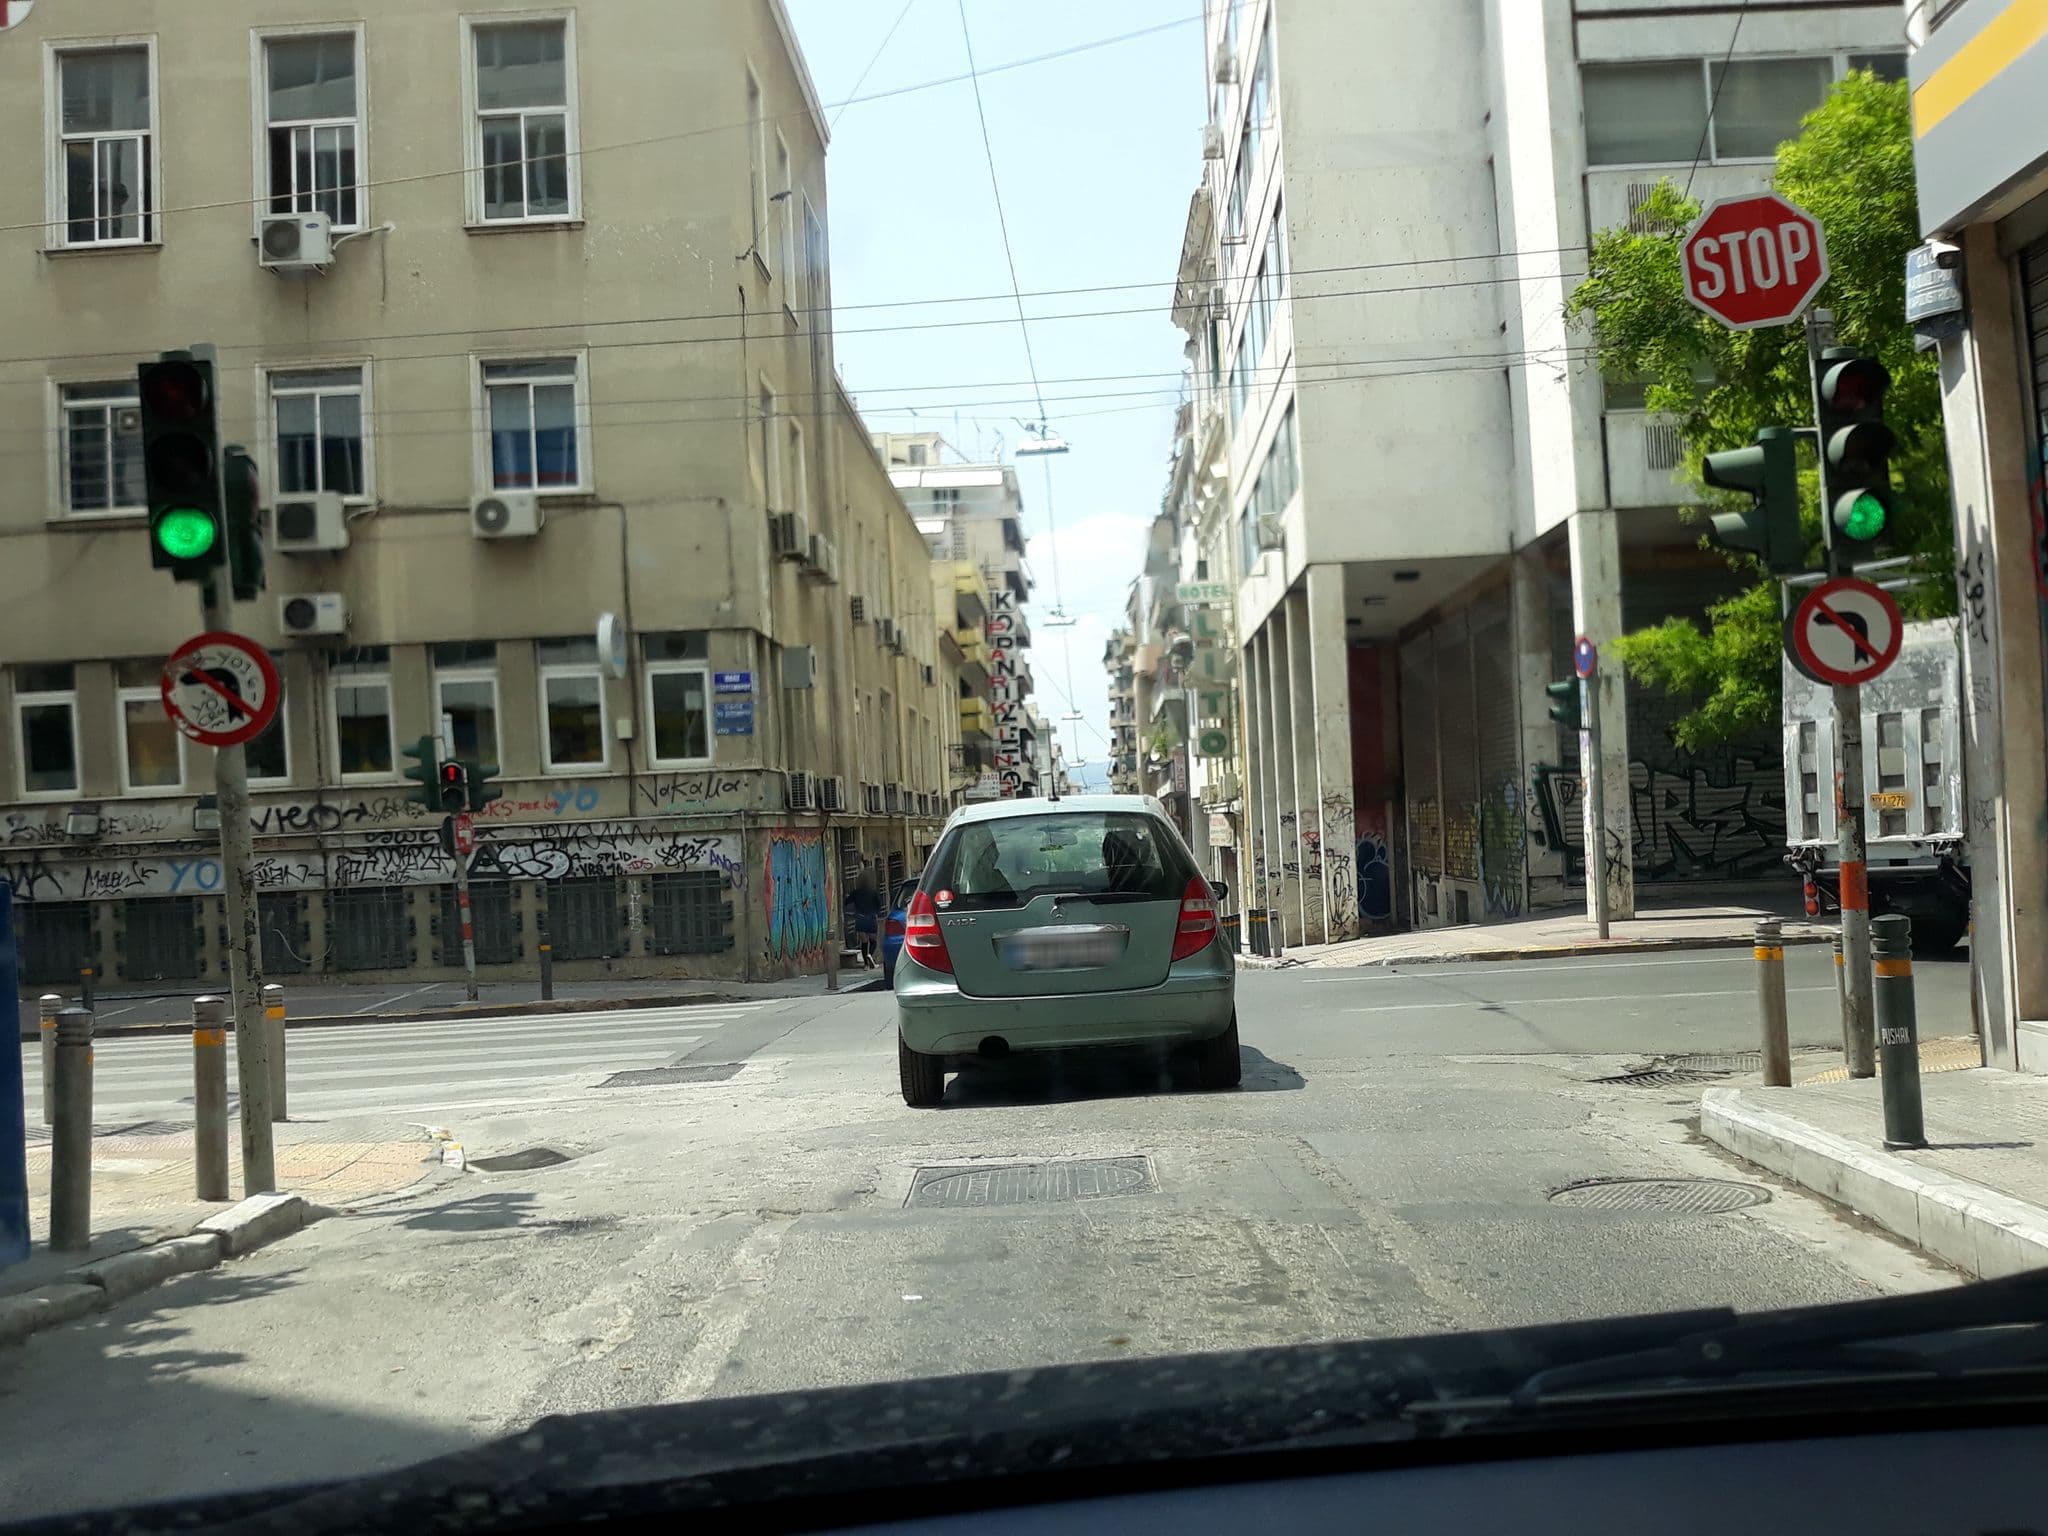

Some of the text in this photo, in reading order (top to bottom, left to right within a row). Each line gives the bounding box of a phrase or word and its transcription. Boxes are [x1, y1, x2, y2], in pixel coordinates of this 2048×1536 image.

[1692, 221, 1811, 299] STOP
[551, 785, 599, 815] YO
[168, 859, 221, 892] YO
